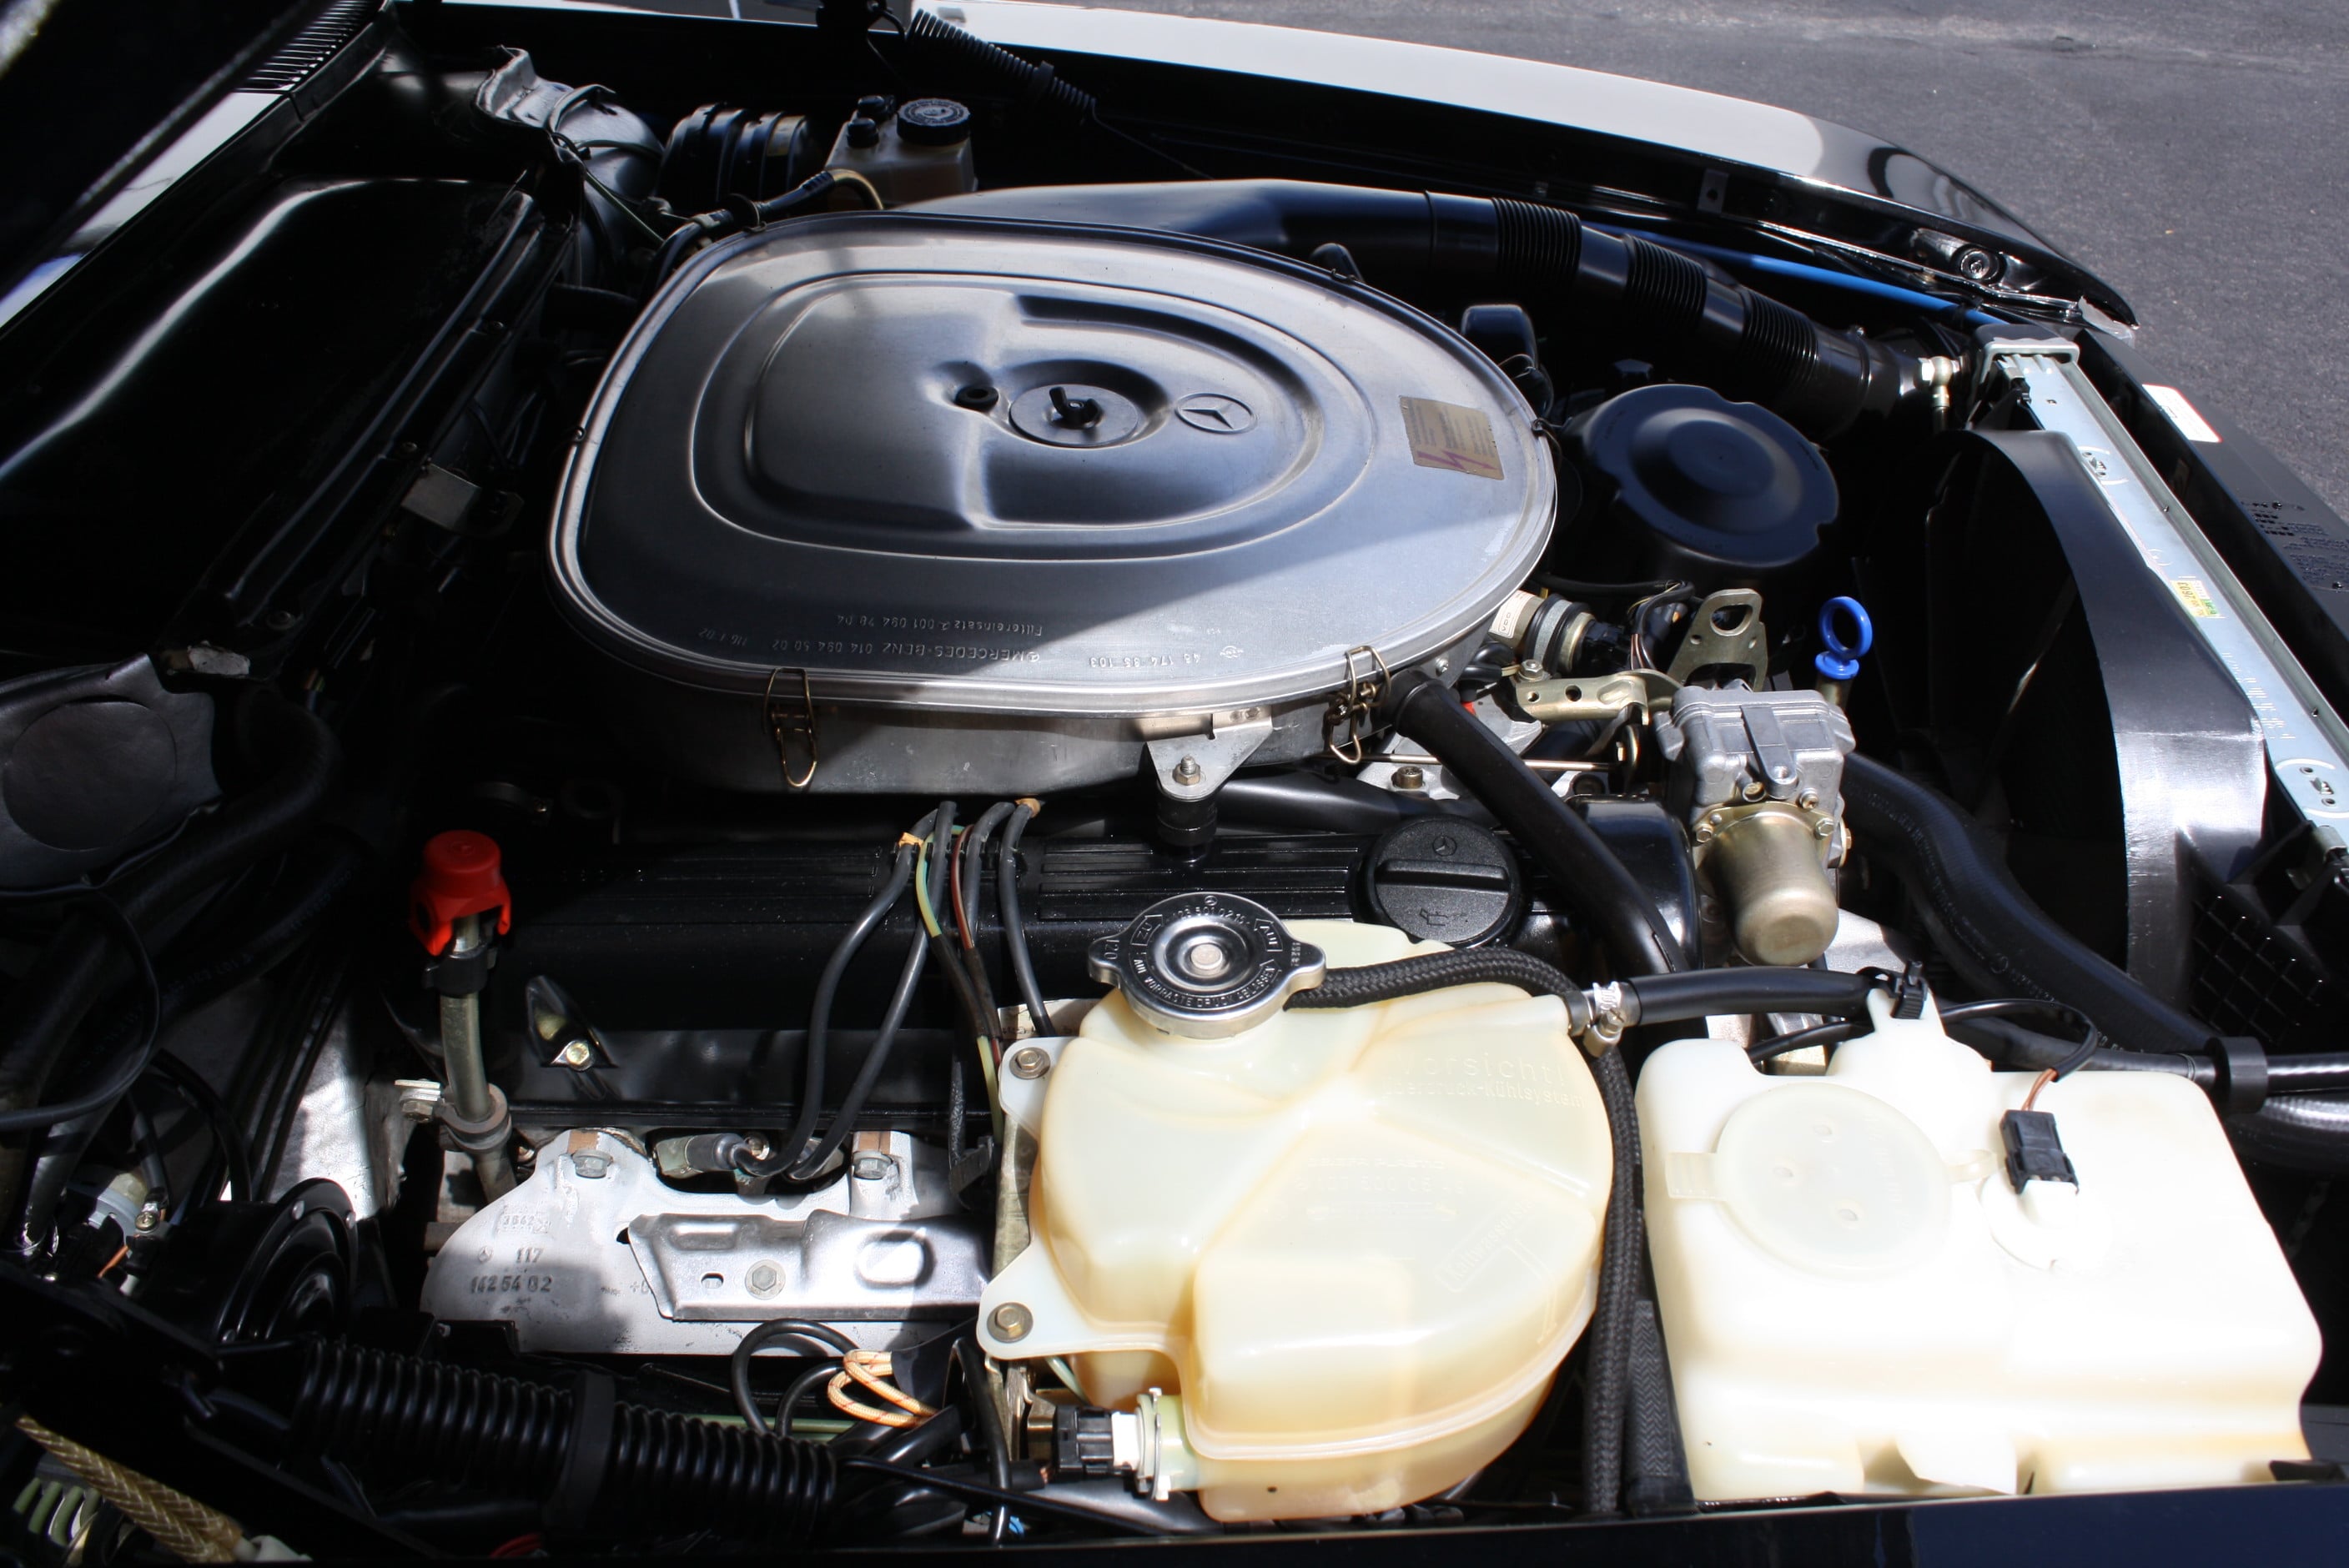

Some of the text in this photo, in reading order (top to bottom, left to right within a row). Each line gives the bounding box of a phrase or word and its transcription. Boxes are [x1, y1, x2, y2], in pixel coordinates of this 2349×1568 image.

[883, 616, 907, 630] 094
[913, 617, 935, 630] 001
[953, 620, 1043, 636] Filtereinsatz
[1501, 612, 1512, 631] VDO
[817, 640, 843, 653] 094
[850, 641, 873, 655] 014
[1089, 656, 1114, 668] 103
[1135, 922, 1154, 939] ZU
[1396, 1051, 1566, 1087] Vorsicht!
[516, 1247, 544, 1264] 117
